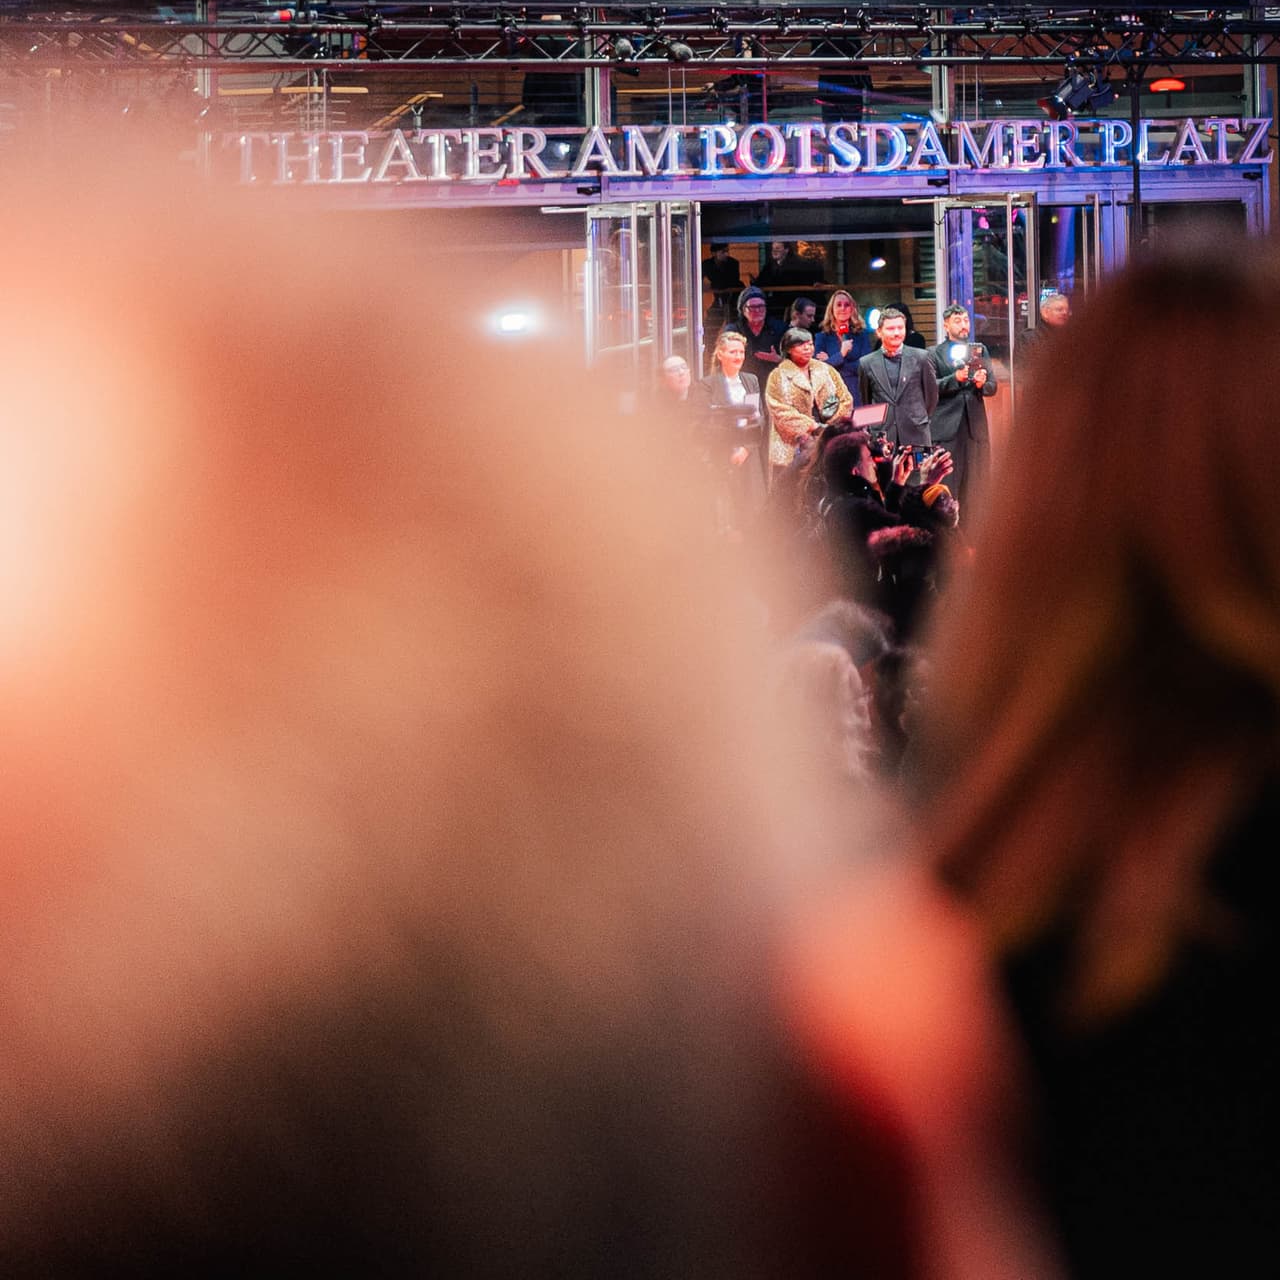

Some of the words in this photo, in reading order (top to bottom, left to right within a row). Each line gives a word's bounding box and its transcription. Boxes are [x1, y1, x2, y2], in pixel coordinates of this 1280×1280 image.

[223, 125, 552, 185] THEATER
[570, 124, 688, 177] AM
[698, 120, 1087, 175] POTSDAMER
[1099, 118, 1274, 167] PLATZ
